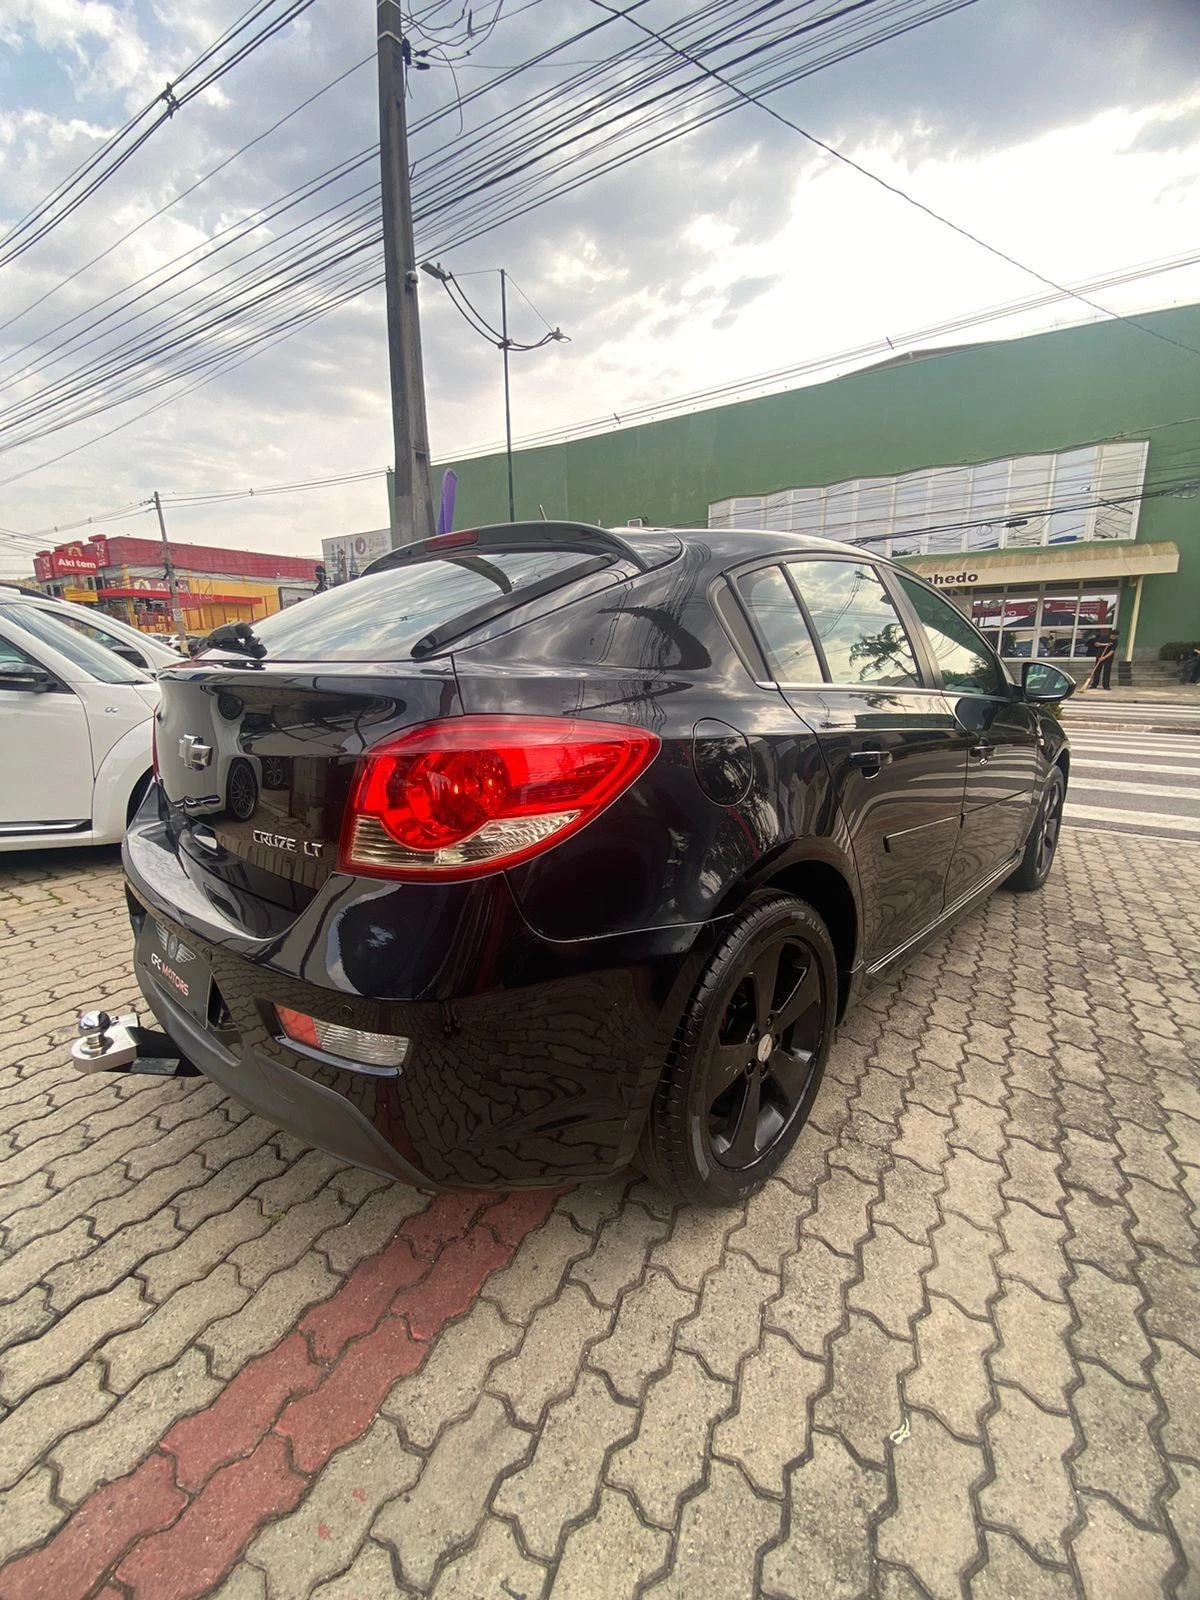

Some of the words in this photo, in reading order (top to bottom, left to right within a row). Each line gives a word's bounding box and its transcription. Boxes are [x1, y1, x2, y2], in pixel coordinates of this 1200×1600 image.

[58, 558, 75, 567] Aki
[76, 560, 96, 569] tem
[252, 829, 297, 853] CRUZE
[303, 841, 323, 857] LT
[162, 962, 189, 996] MOTORS
